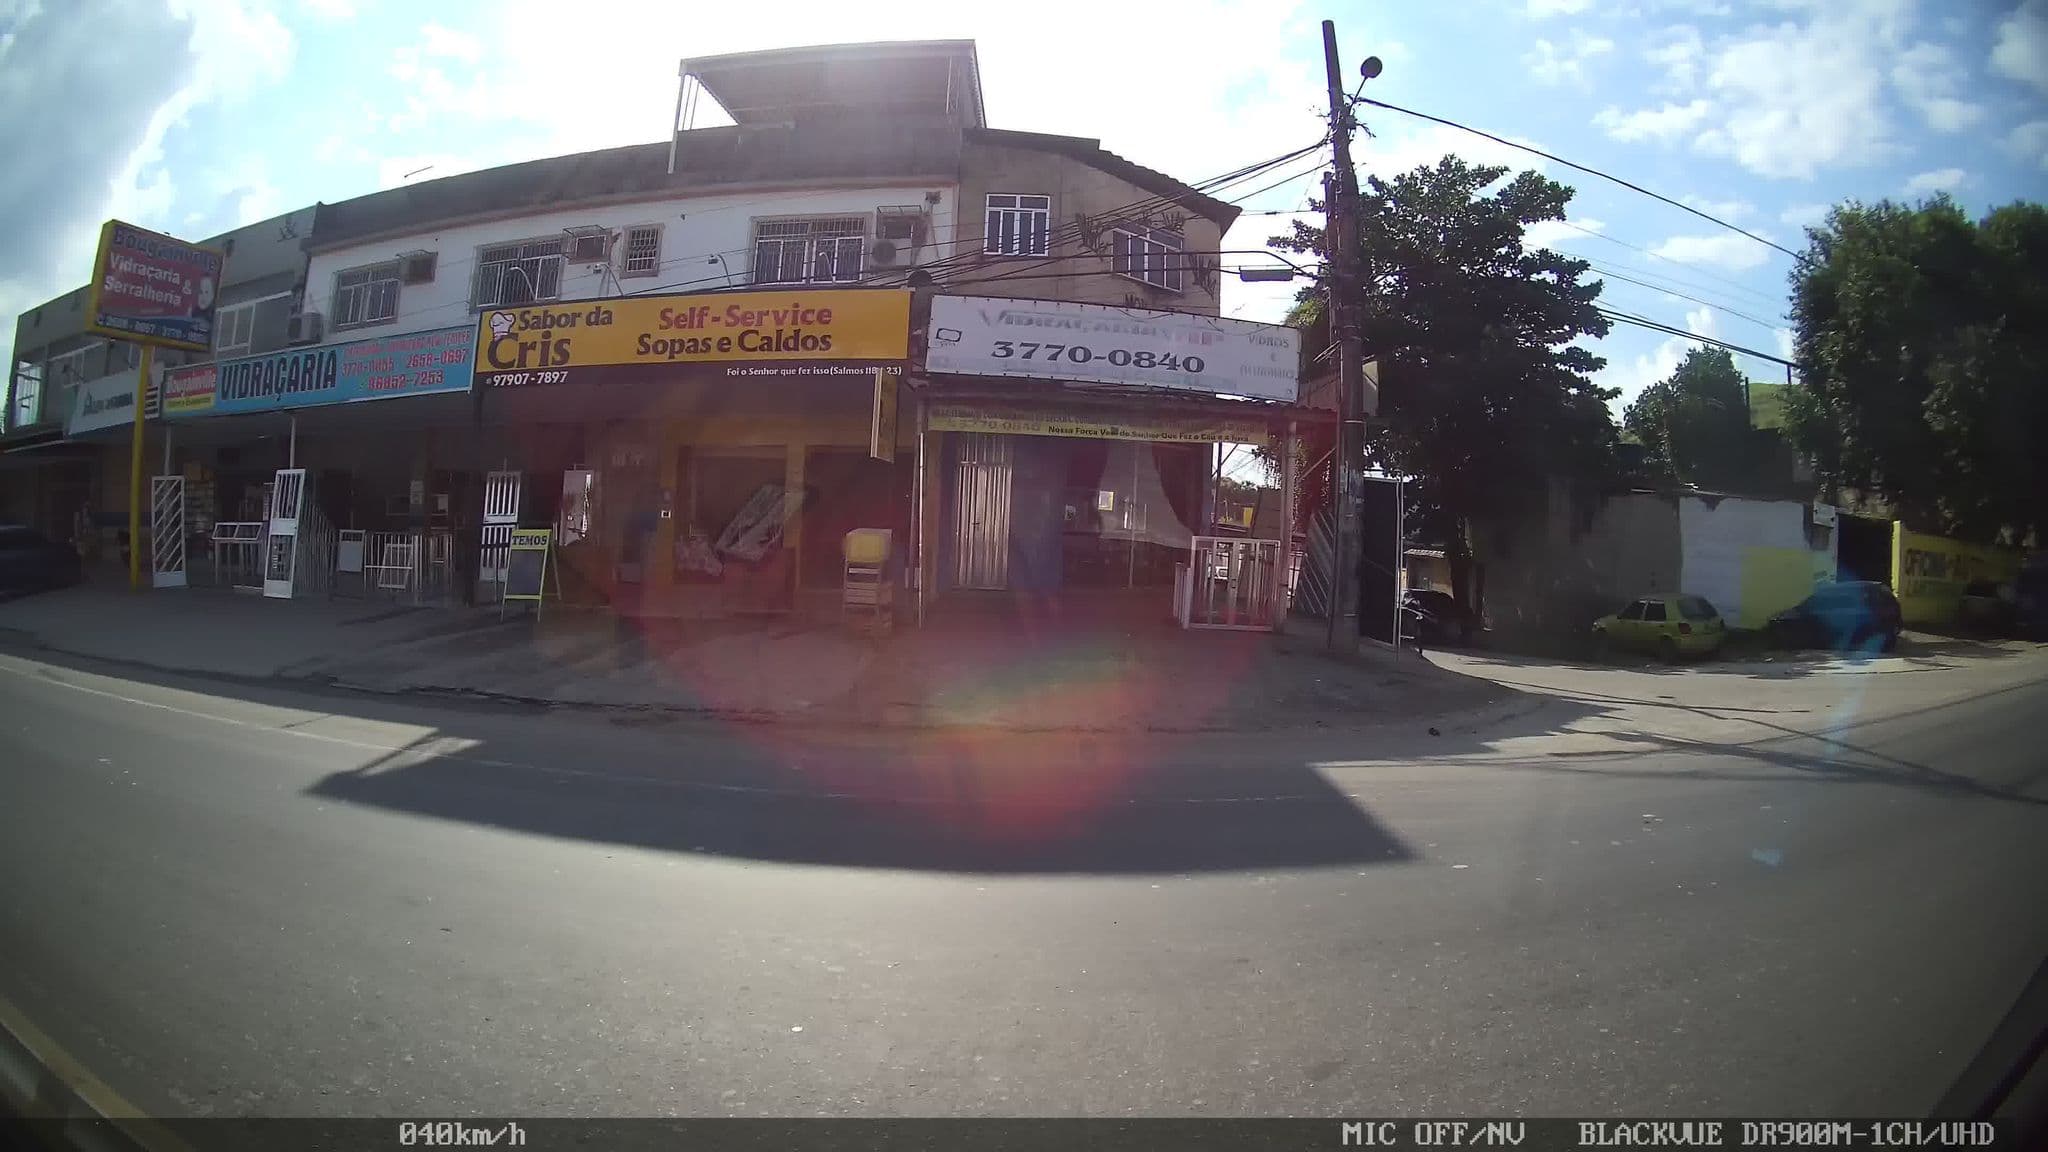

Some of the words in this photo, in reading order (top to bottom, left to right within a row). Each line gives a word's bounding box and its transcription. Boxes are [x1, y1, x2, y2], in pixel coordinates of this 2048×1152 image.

[110, 251, 180, 284] Vidraçaria
[104, 275, 182, 305] Serralheria
[518, 309, 581, 331] Sabor
[585, 306, 613, 326] da
[487, 330, 571, 370] Cris
[637, 333, 712, 359] Sopas
[716, 335, 731, 352] e
[738, 329, 832, 353] Caldos
[991, 341, 1205, 373] 3770-0840
[219, 350, 337, 402] VIDRAÇARIA
[493, 370, 568, 387] 97907-7897
[727, 367, 739, 376] Foi
[749, 367, 778, 376] Senhor
[512, 535, 548, 546] TEMOS
